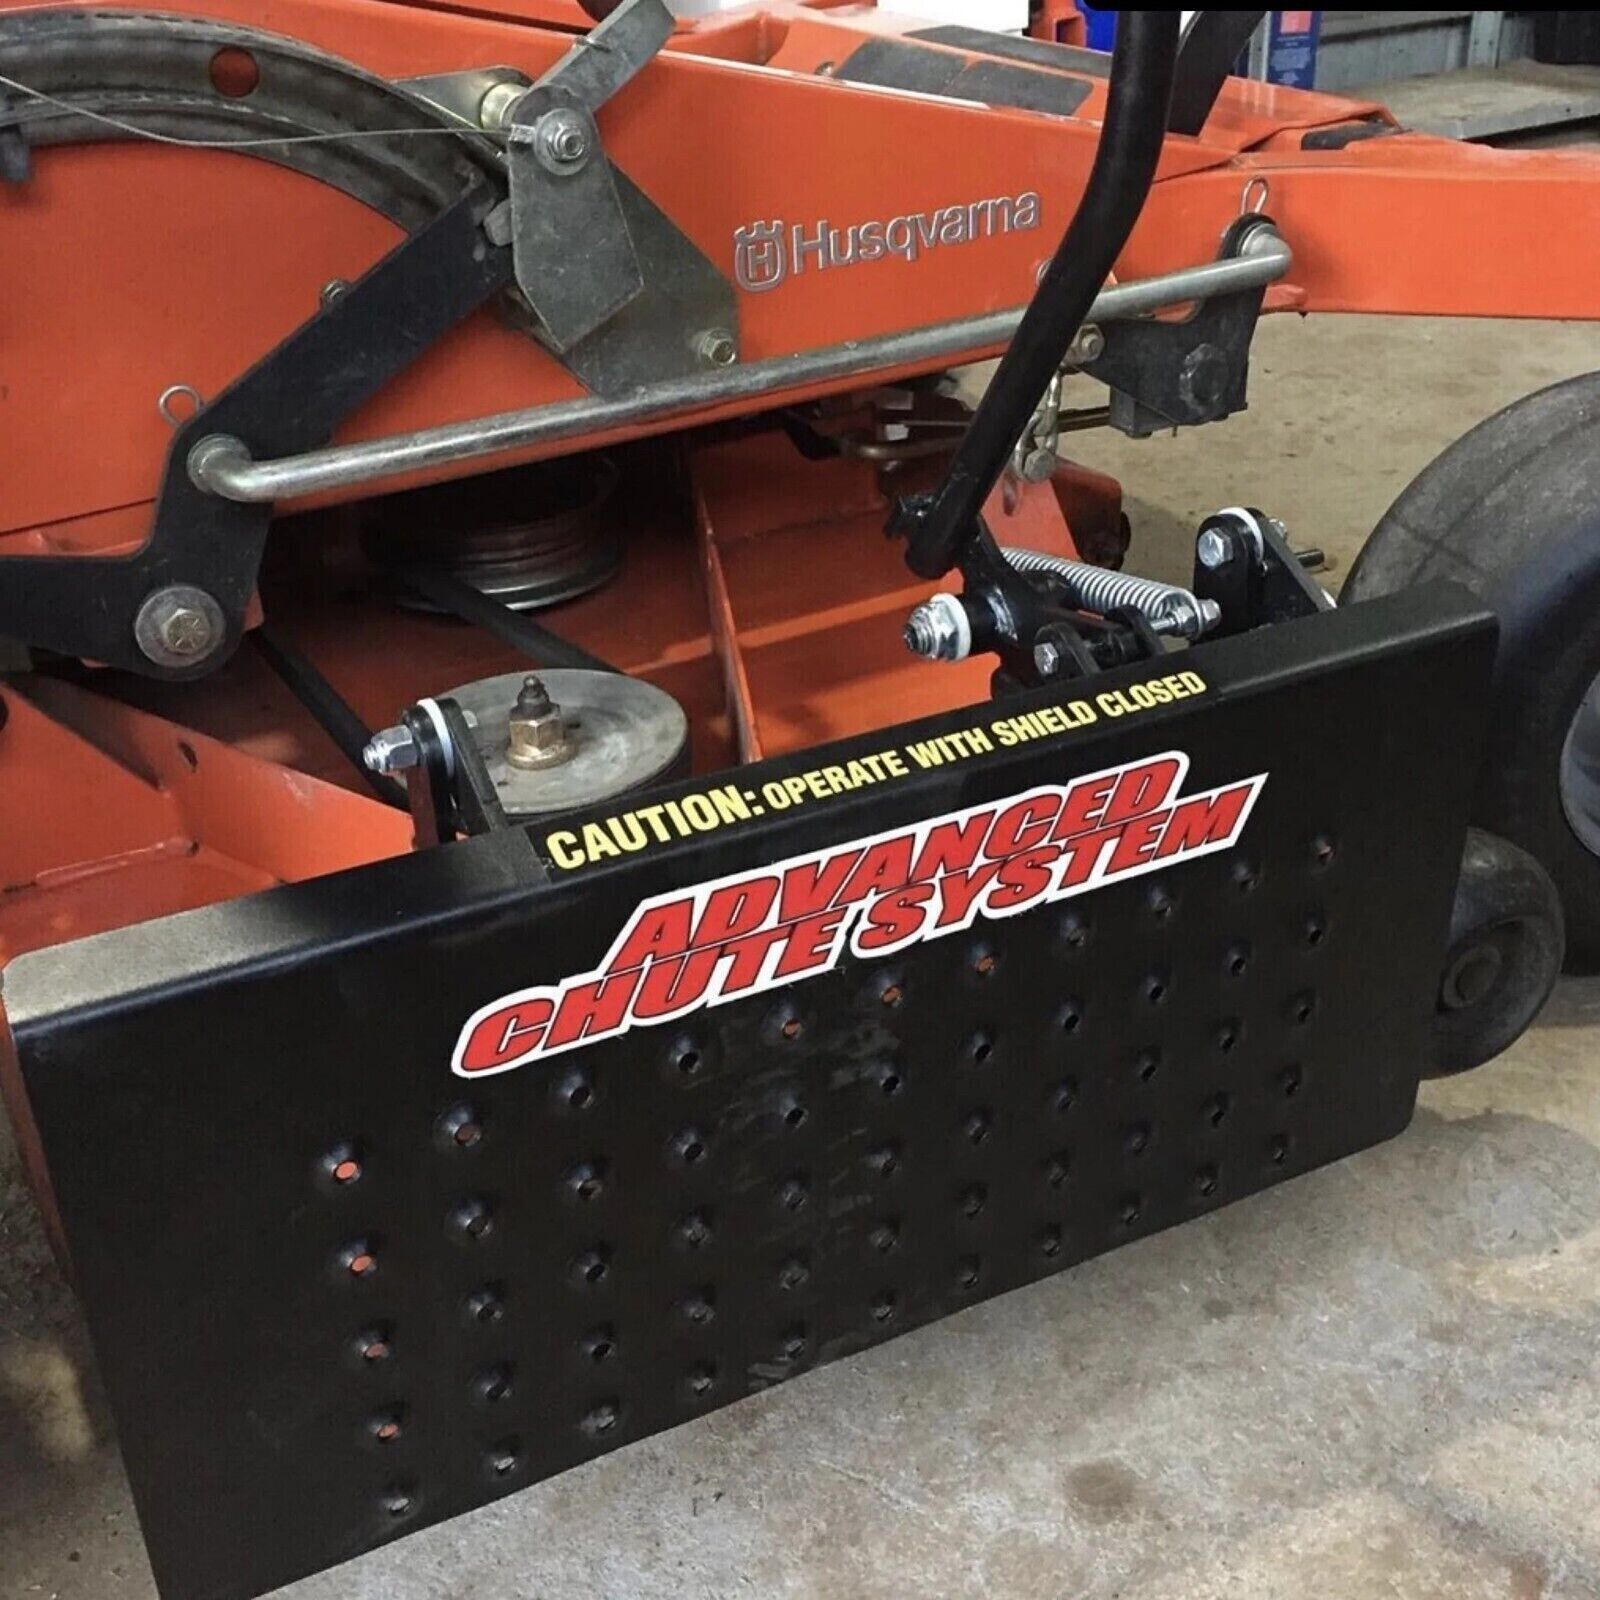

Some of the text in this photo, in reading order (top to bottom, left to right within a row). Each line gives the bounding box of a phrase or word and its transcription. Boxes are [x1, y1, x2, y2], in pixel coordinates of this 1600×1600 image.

[793, 192, 1039, 274] Husqvarna
[546, 671, 1207, 870] CAUTION: OPERATE WITH SHIELD CLOSED
[604, 759, 1180, 974] ADVANCED
[461, 784, 1254, 1072] CHUTE SYSTEM
